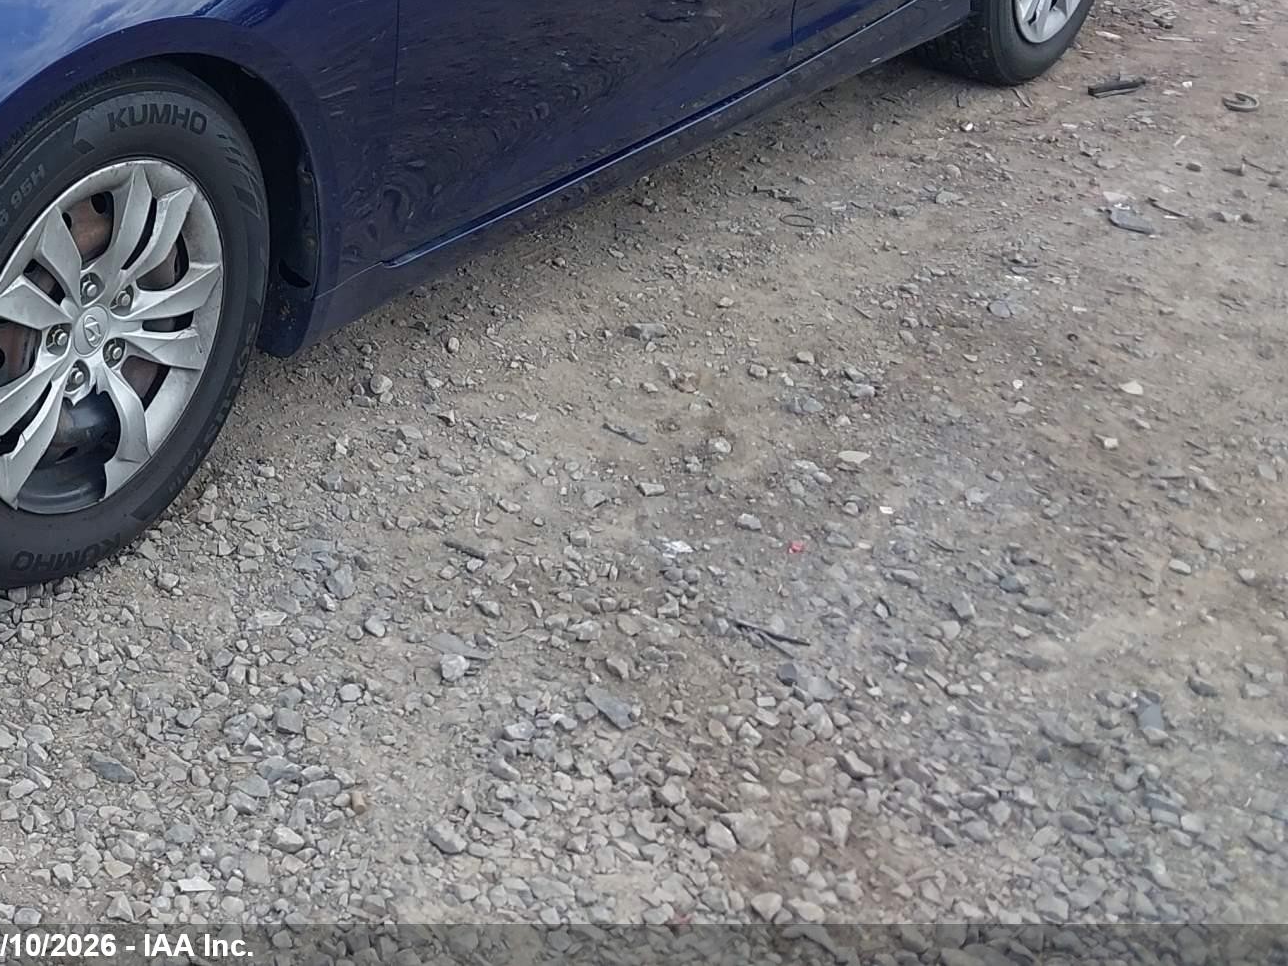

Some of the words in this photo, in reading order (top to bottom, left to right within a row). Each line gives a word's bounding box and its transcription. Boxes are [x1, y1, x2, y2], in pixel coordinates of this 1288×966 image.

[107, 103, 208, 135] KUMHO
[10, 162, 47, 209] 95H
[10, 531, 121, 572] KUMHO
